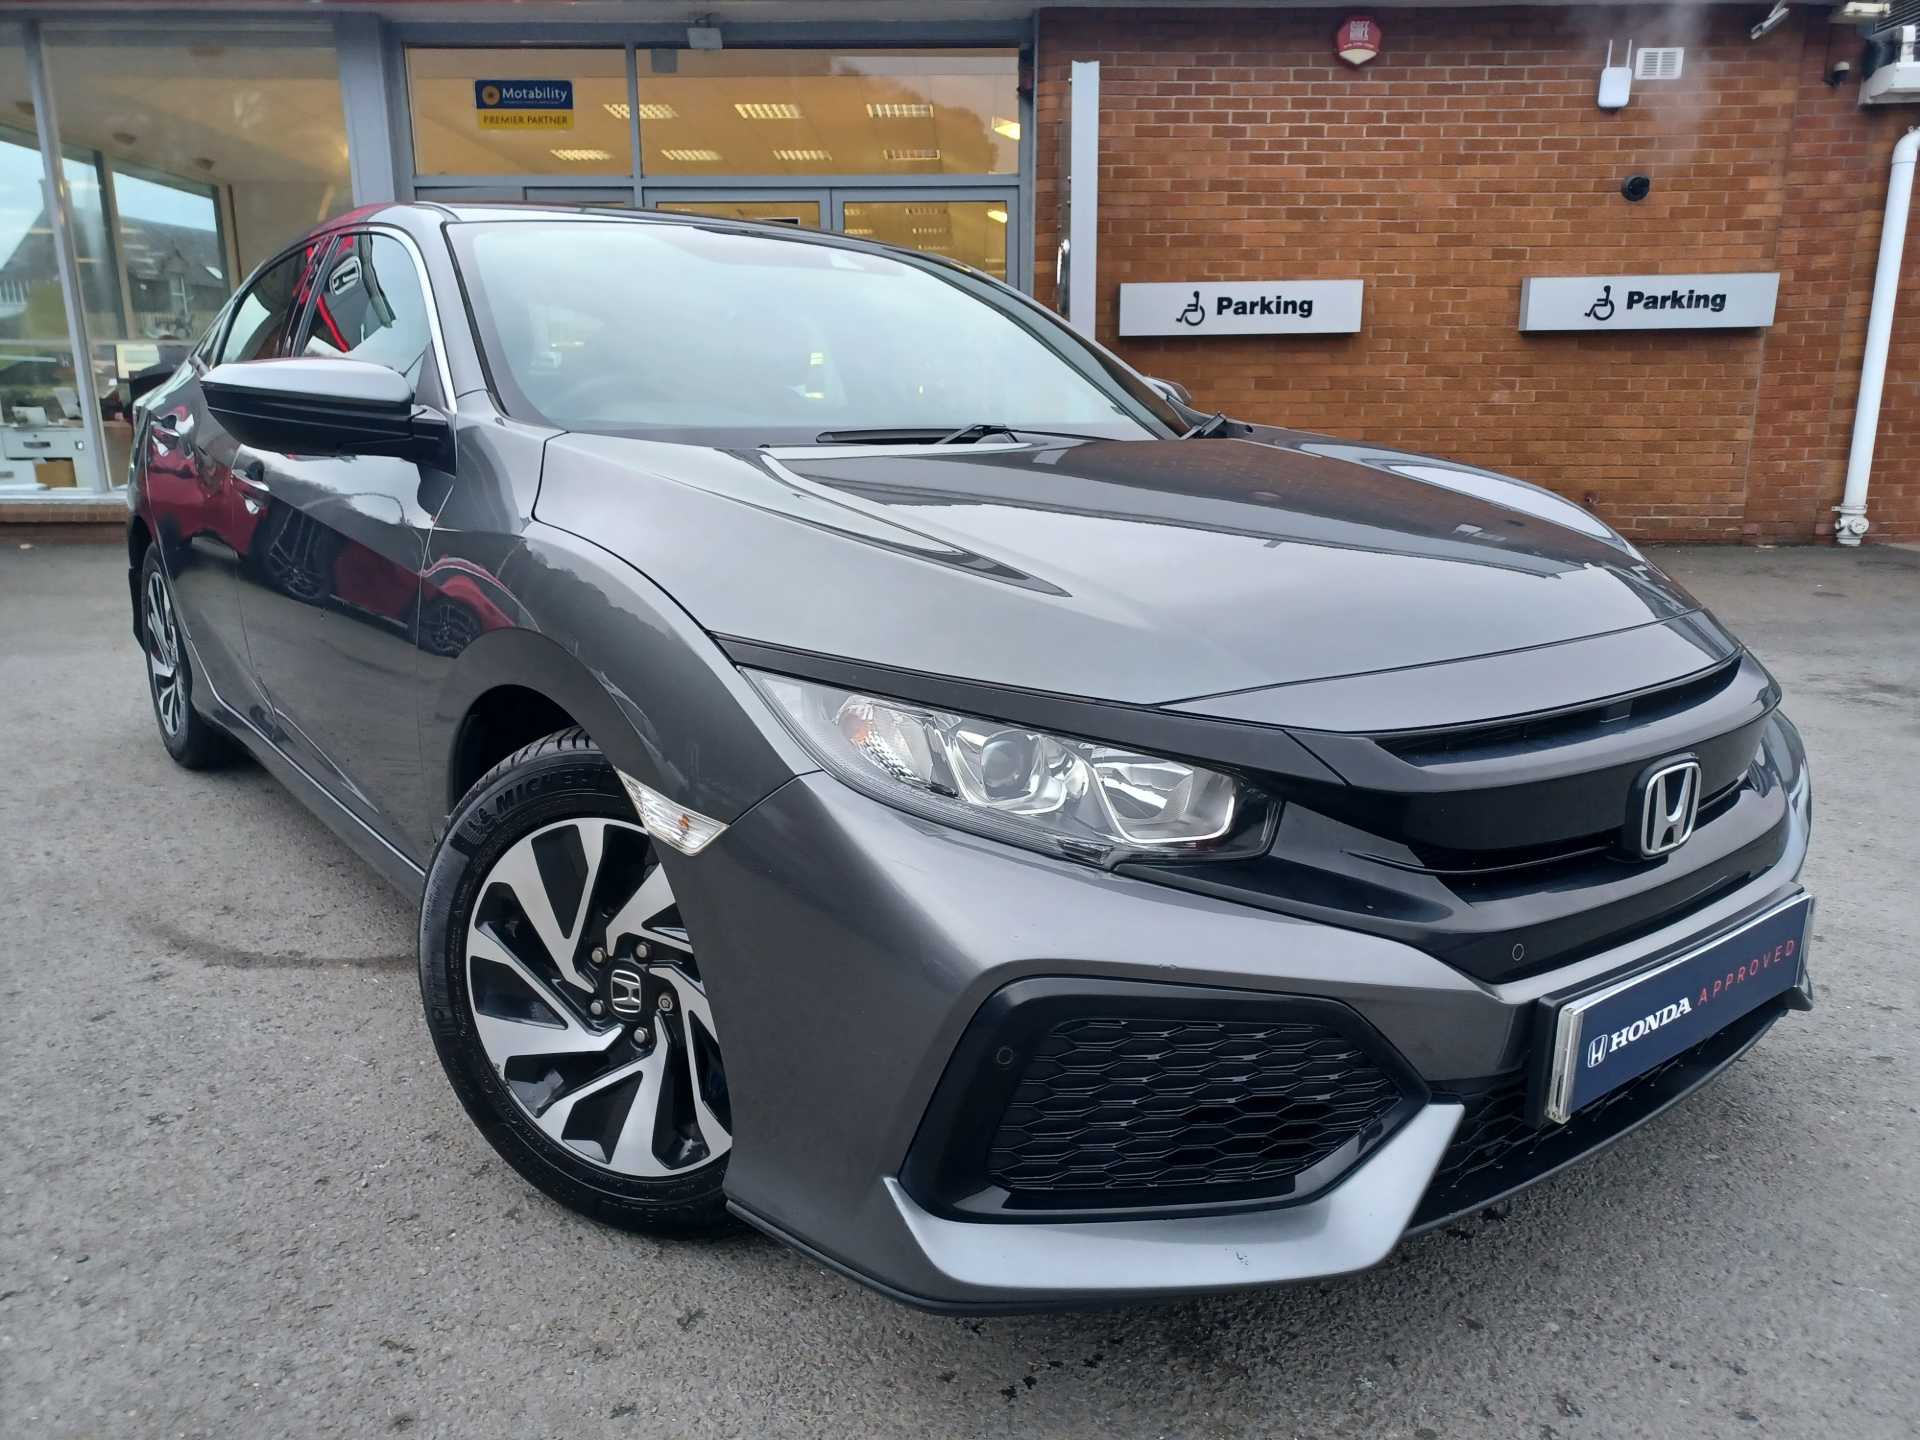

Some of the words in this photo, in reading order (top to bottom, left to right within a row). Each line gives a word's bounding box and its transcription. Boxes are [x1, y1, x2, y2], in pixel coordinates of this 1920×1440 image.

[502, 86, 568, 102] Motability
[483, 115, 525, 125] PREMIER
[528, 115, 568, 125] PARTNER
[1217, 295, 1313, 318] Parking
[1626, 289, 1727, 312] Parking
[1609, 997, 1692, 1053] HONDA
[1697, 939, 1795, 1006] APPROVED
